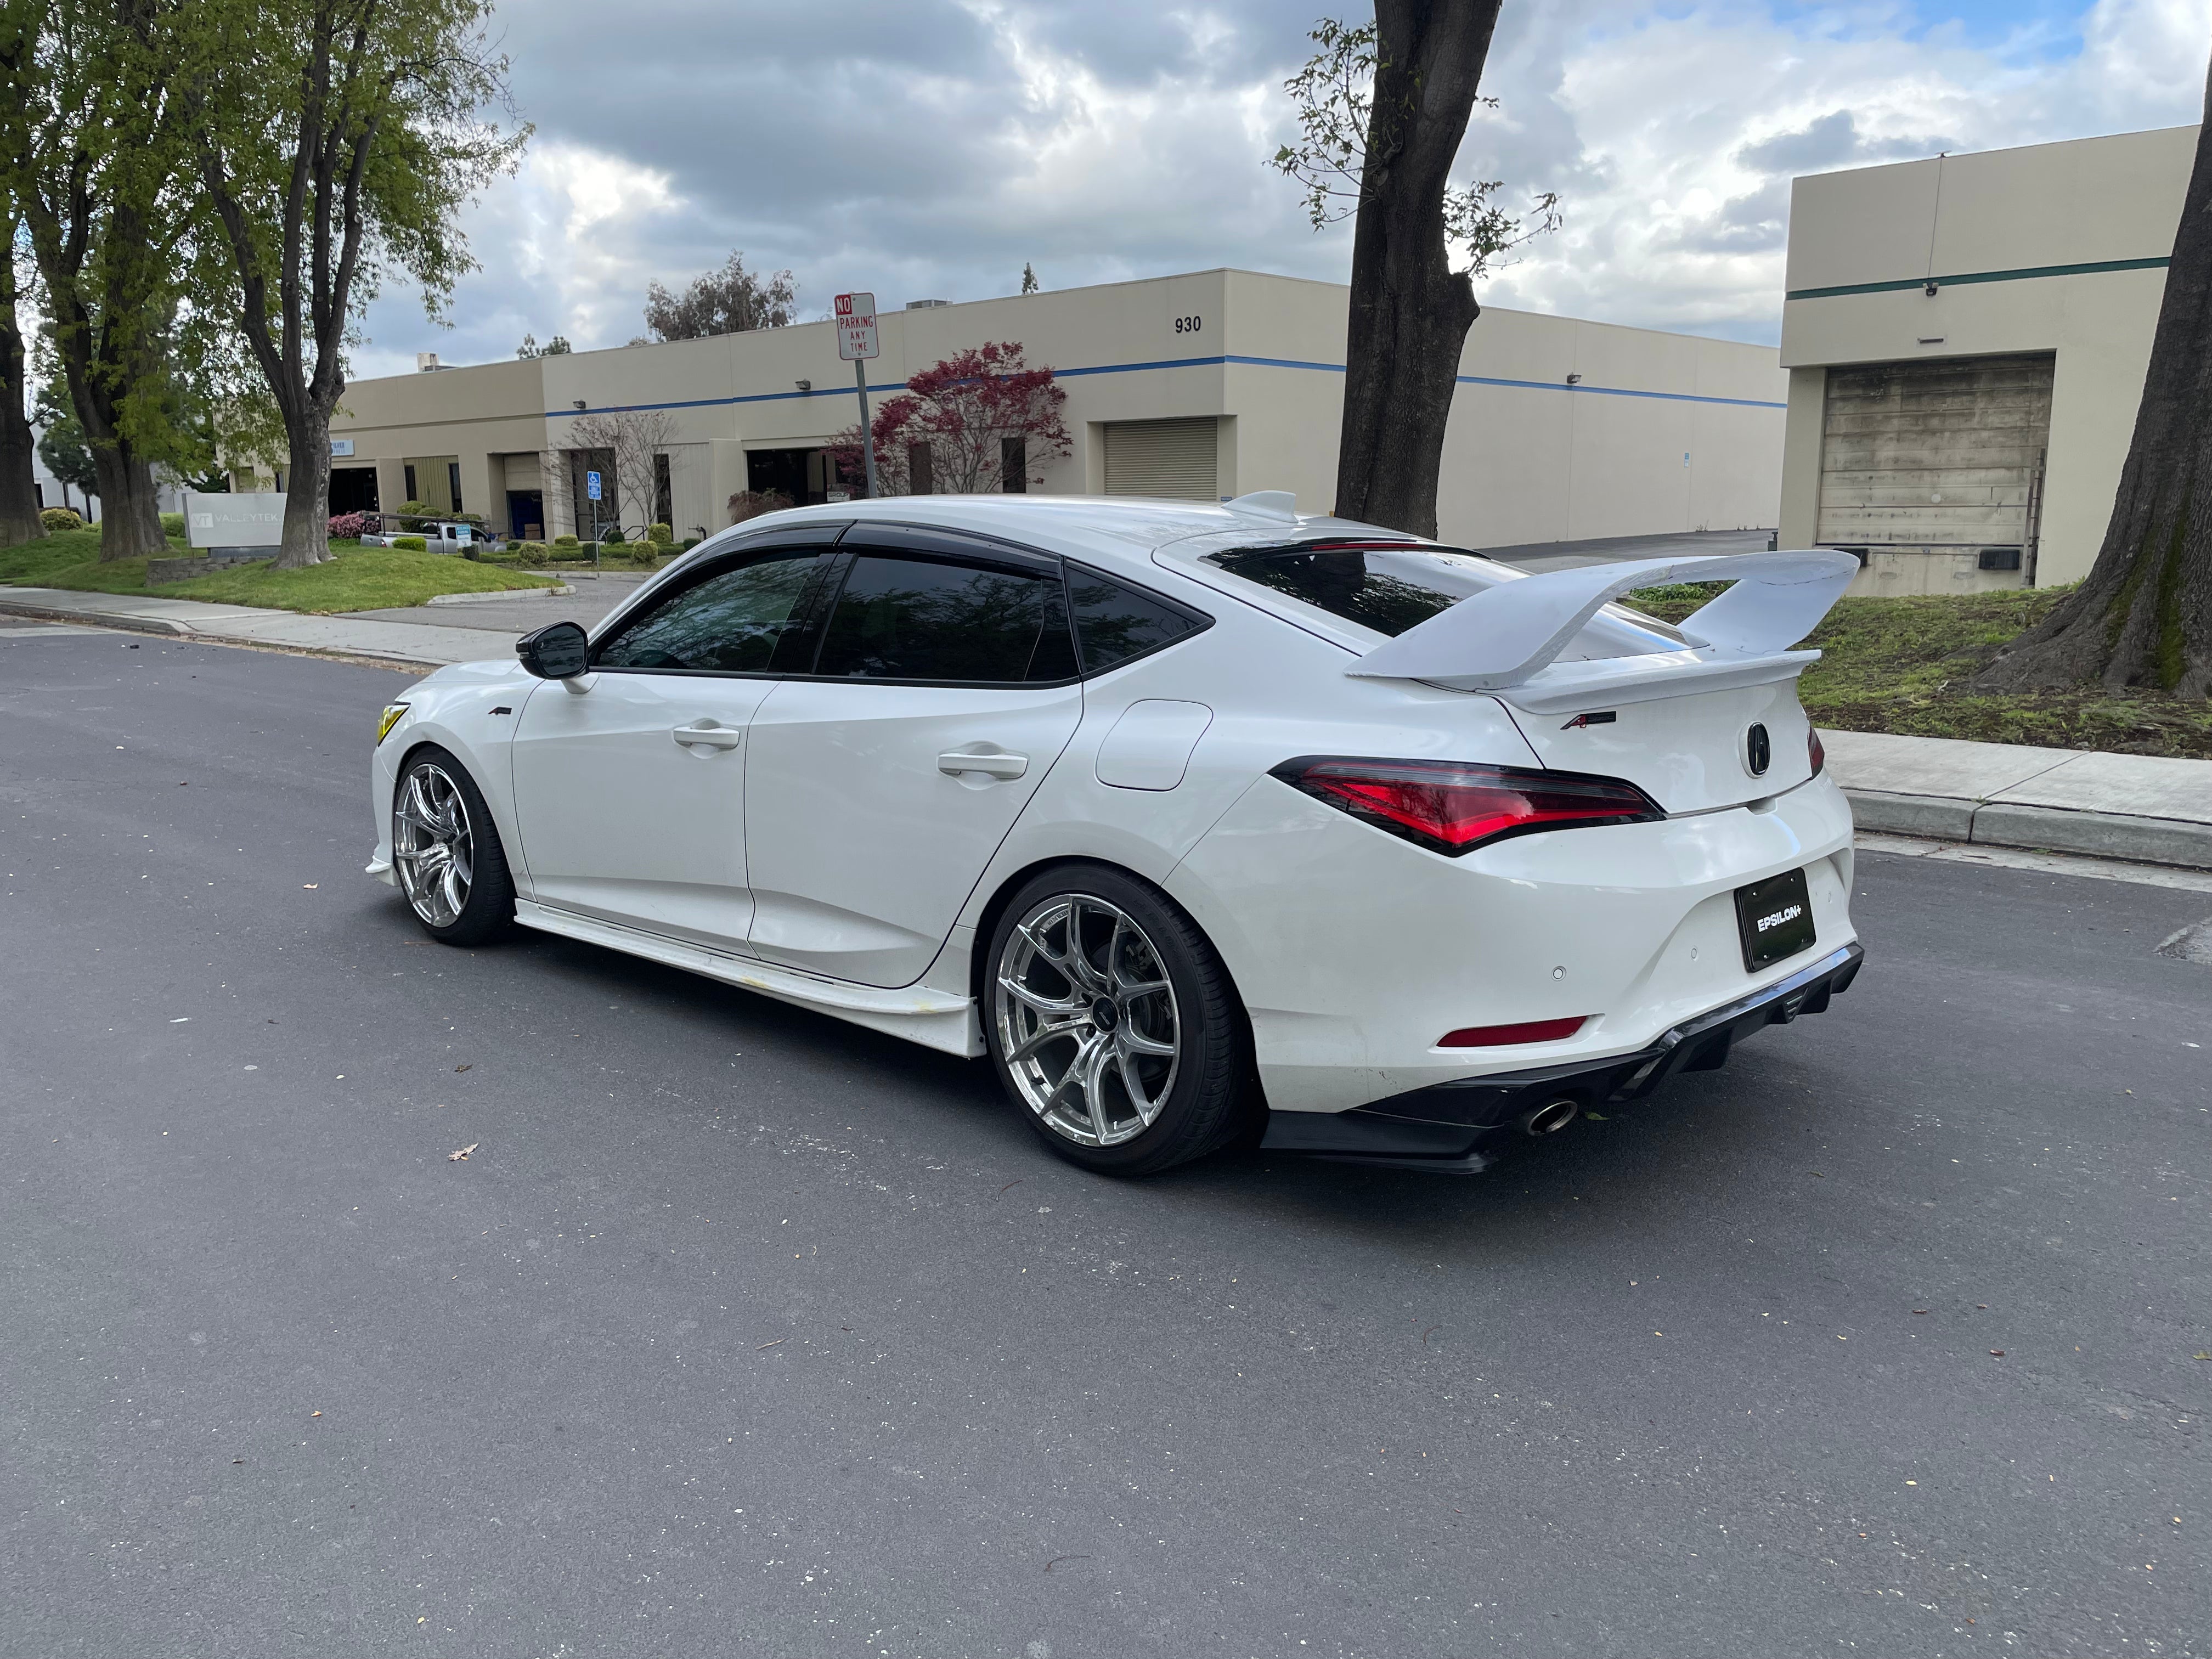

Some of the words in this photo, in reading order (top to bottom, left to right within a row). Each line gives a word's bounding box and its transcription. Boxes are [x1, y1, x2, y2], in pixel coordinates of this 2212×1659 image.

[837, 297, 850, 313] NO
[840, 315, 873, 330] PARKING
[1175, 315, 1201, 334] 930
[850, 330, 866, 341] ANY
[850, 342, 868, 352] TIME
[1757, 905, 1802, 932] EPSILON+
